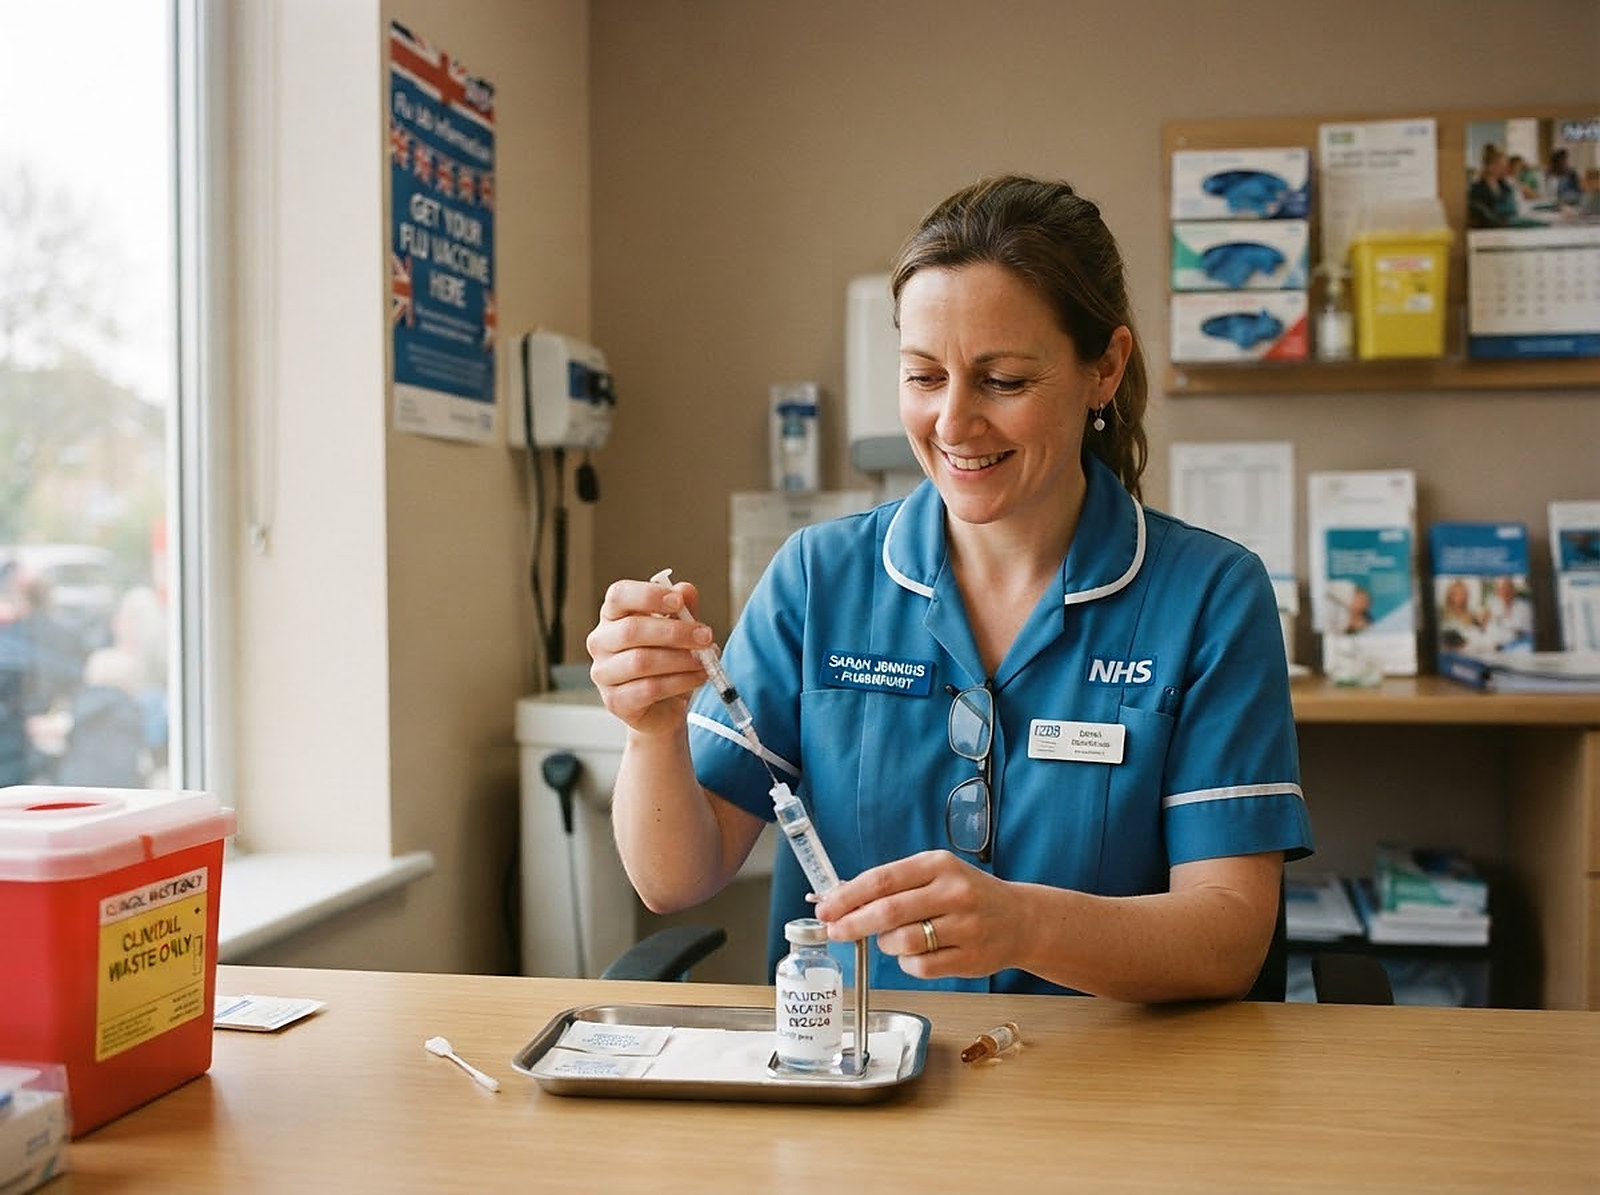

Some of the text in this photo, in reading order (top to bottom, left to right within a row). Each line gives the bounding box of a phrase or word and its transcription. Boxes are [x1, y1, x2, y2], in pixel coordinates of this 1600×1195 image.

[410, 193, 482, 246] GET YOUR
[1088, 658, 1154, 685] NHS
[109, 948, 156, 983] WASTE
